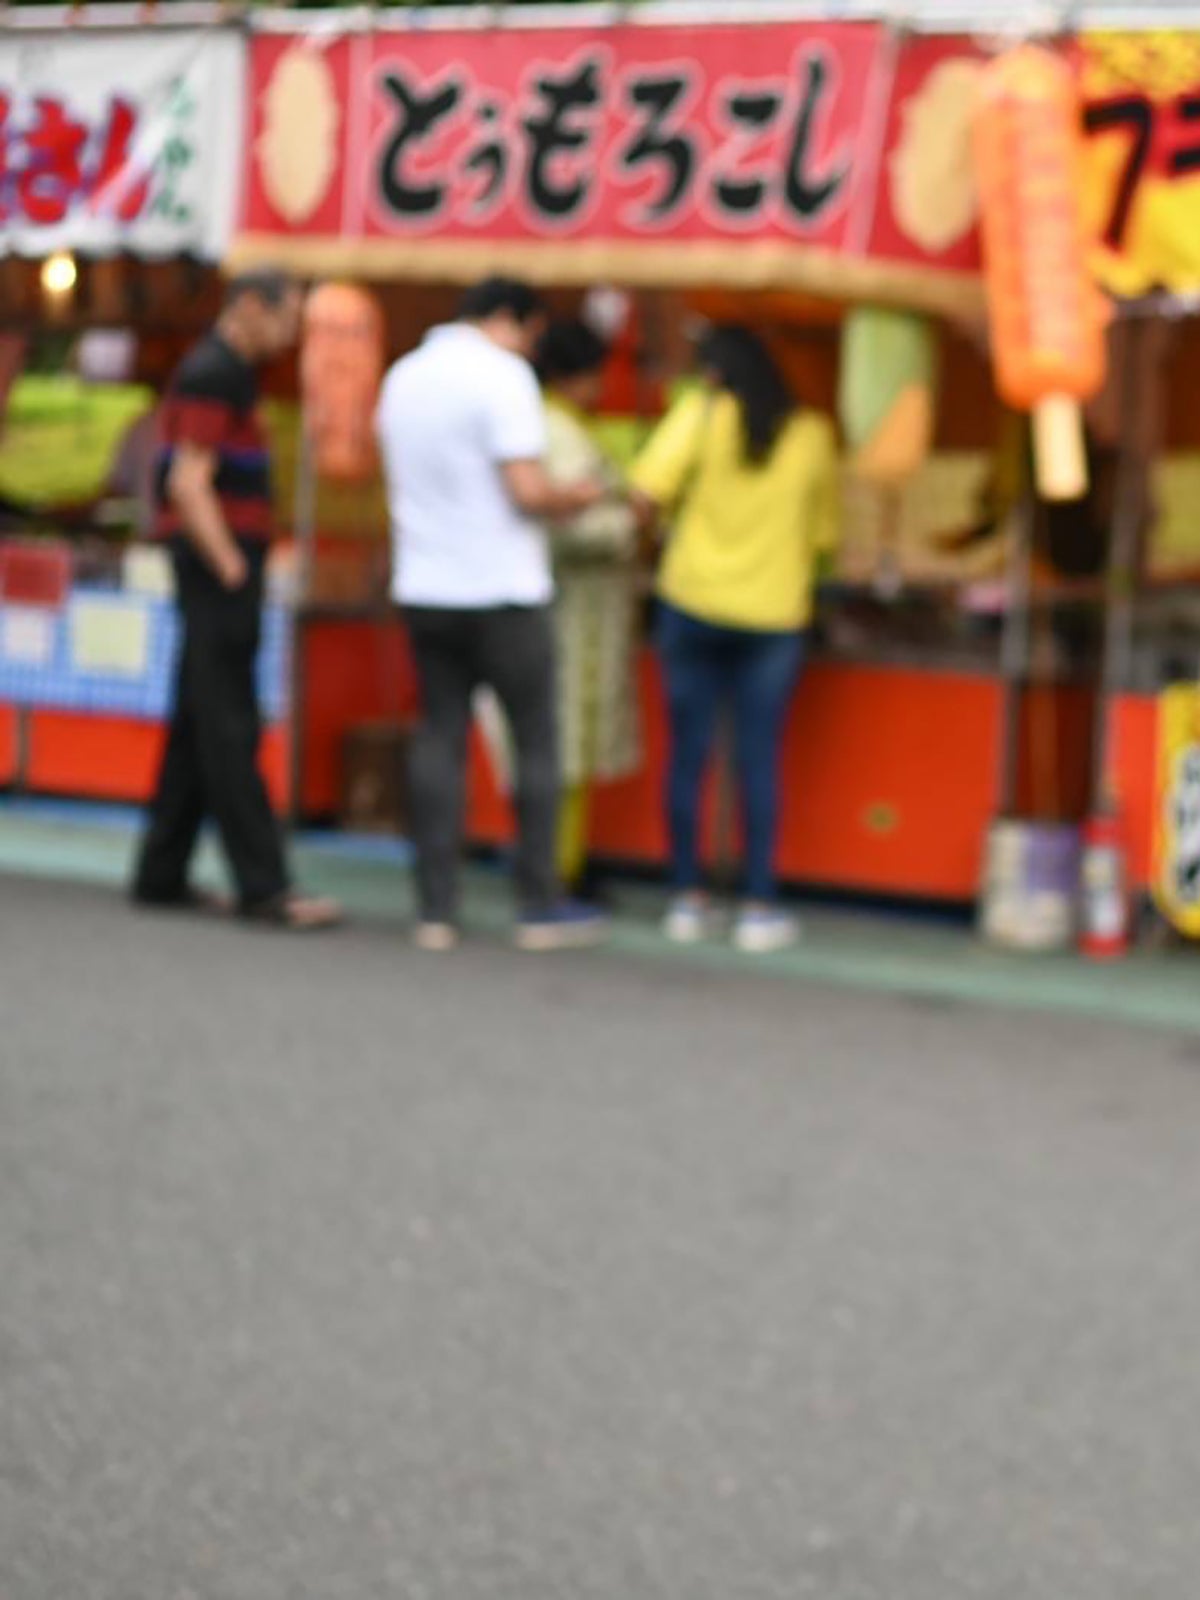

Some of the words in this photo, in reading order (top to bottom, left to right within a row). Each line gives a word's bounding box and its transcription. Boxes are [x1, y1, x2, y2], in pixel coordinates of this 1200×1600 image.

[374, 58, 852, 218] とうもろこし
